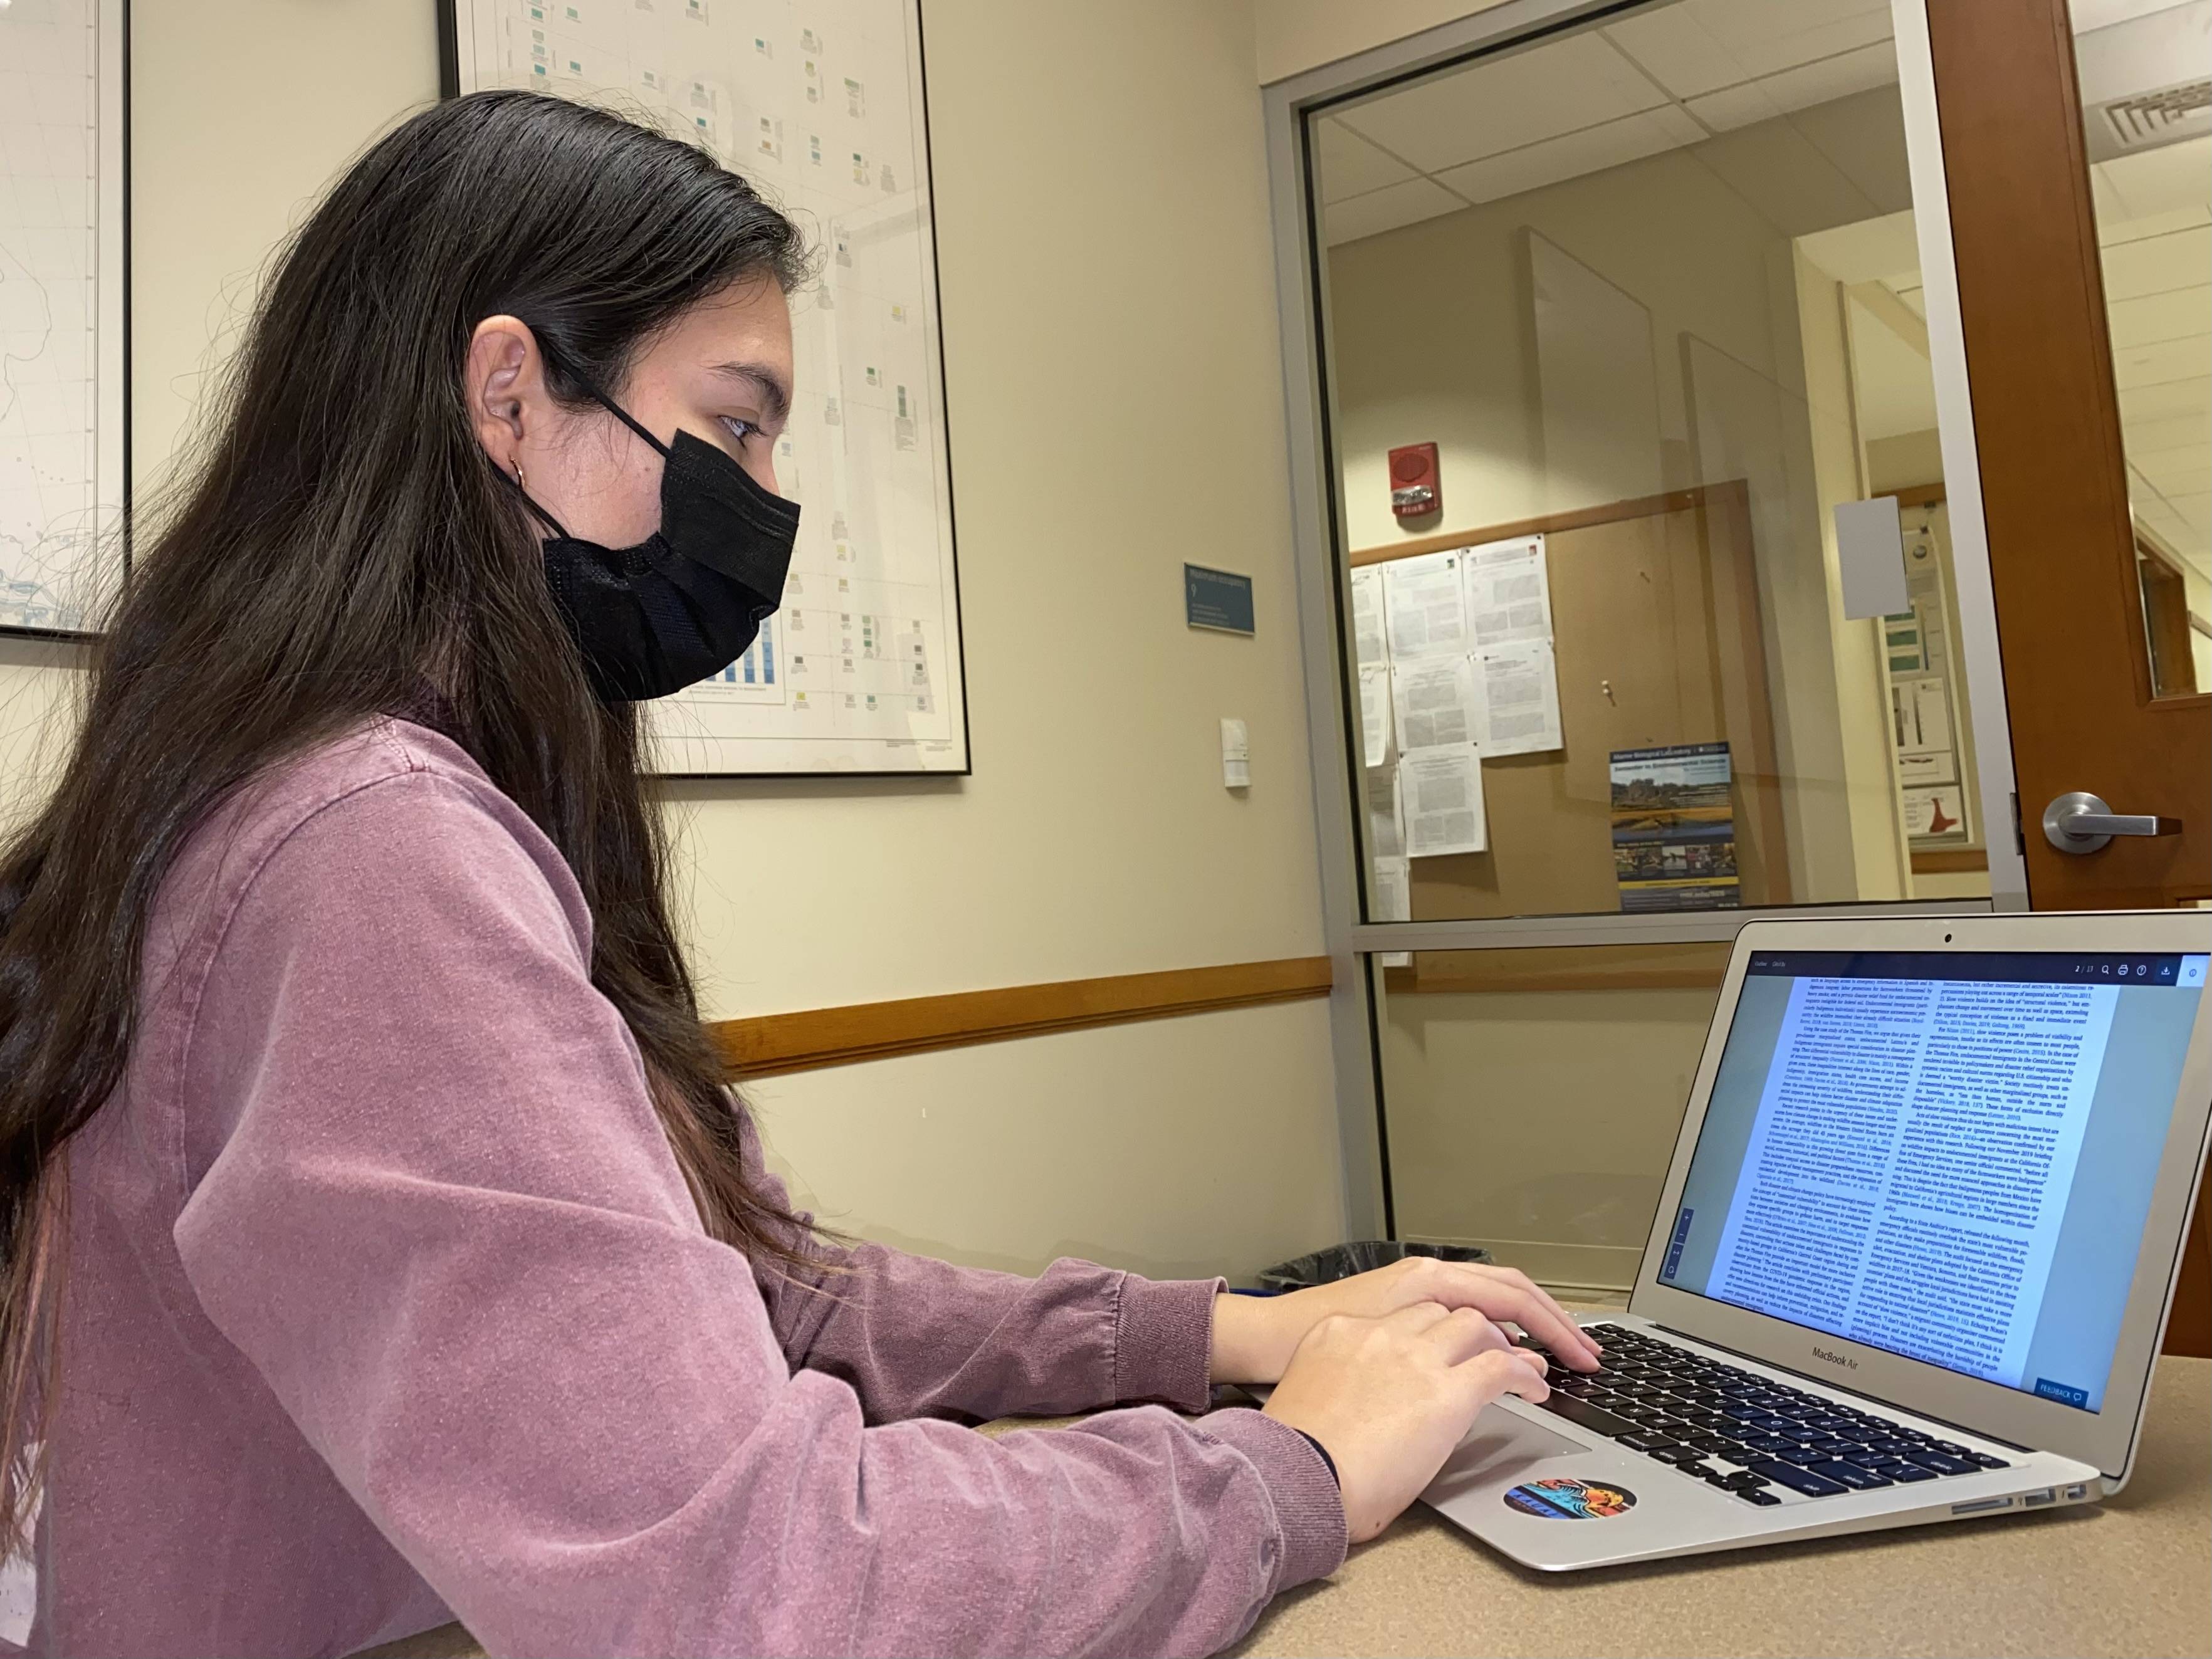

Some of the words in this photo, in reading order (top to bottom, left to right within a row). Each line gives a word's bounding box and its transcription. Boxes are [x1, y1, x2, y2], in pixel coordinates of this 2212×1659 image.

[1191, 584, 1197, 597] 9
[1812, 1347, 1846, 1366] MacBook
[1847, 1359, 1858, 1370] Air
[2041, 1384, 2070, 1398] FEEDBACK
